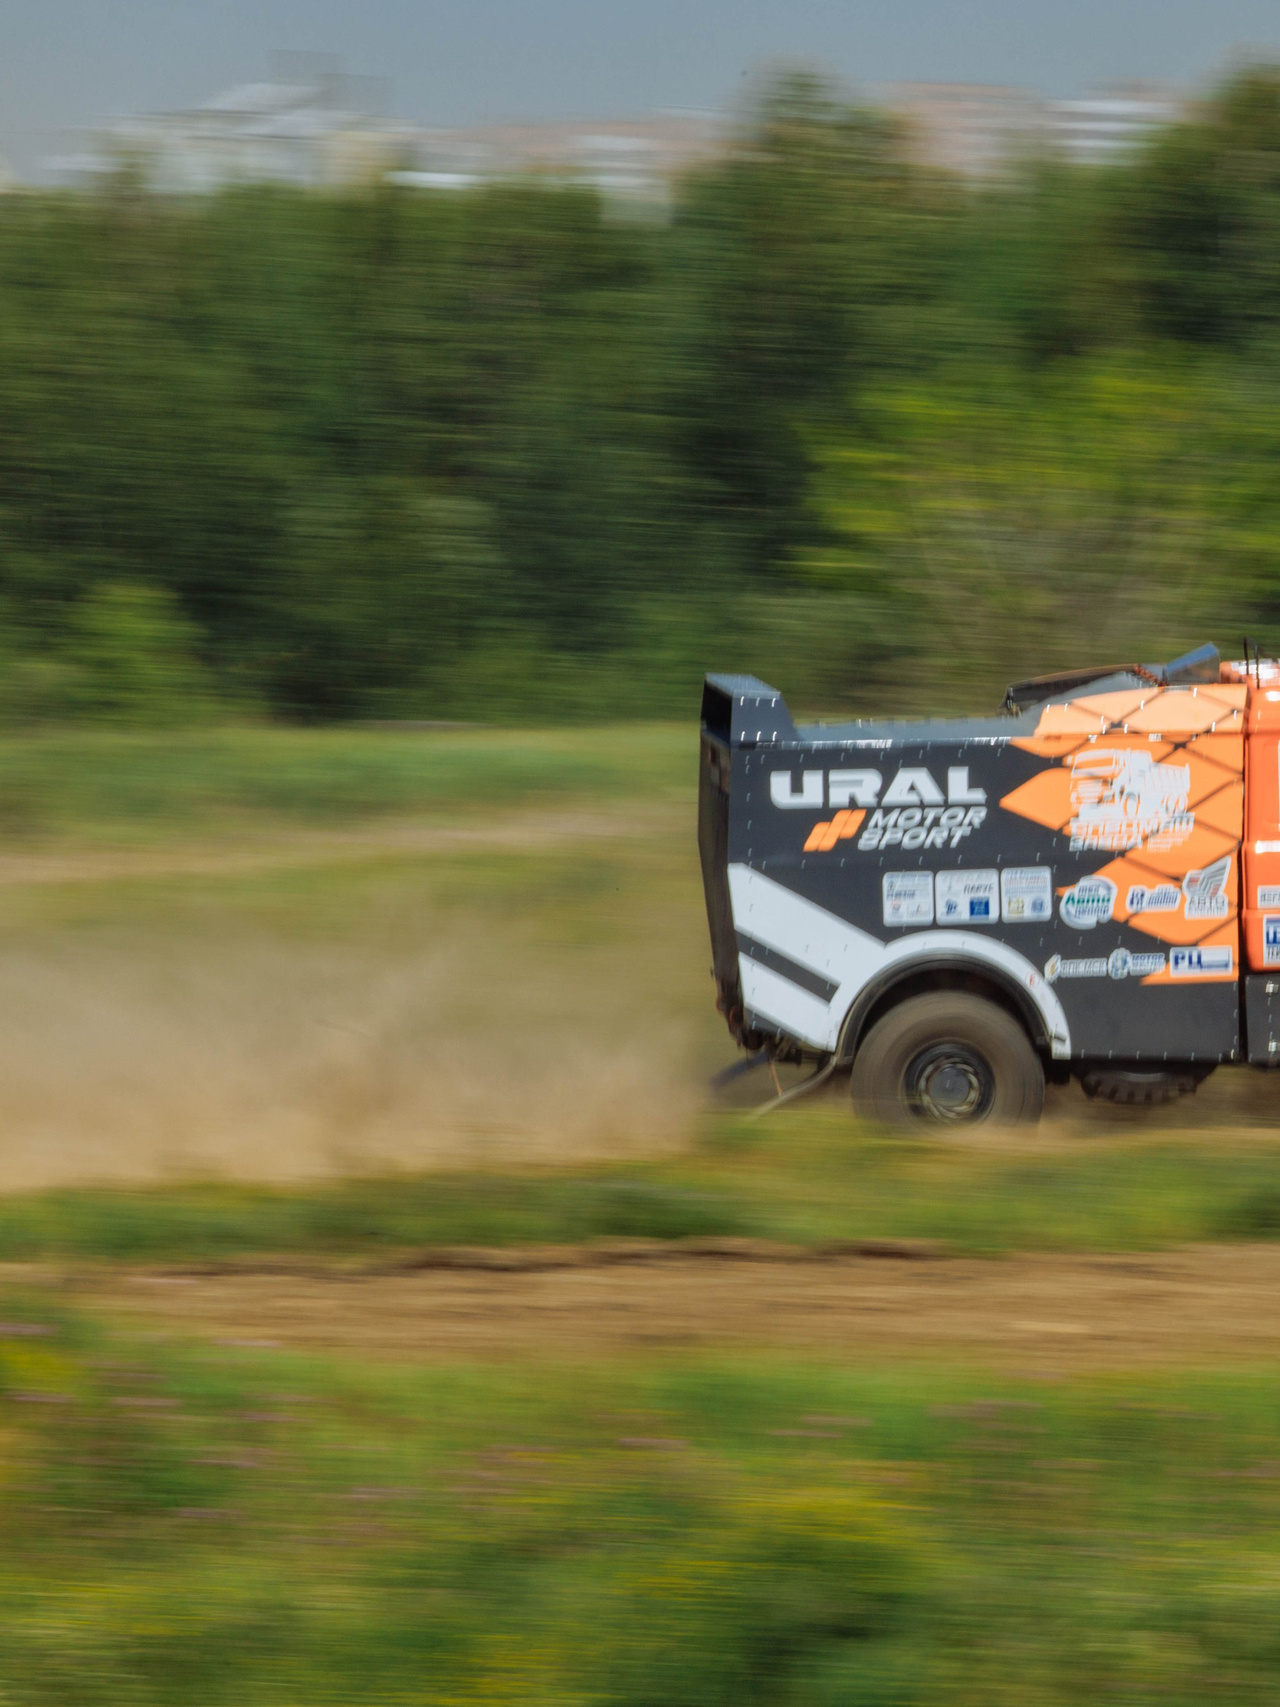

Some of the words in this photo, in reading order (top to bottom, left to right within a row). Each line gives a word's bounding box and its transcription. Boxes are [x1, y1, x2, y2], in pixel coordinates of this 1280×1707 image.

[770, 766, 988, 809] URAL
[867, 806, 988, 829] MOTOR
[857, 826, 972, 850] SPORT
